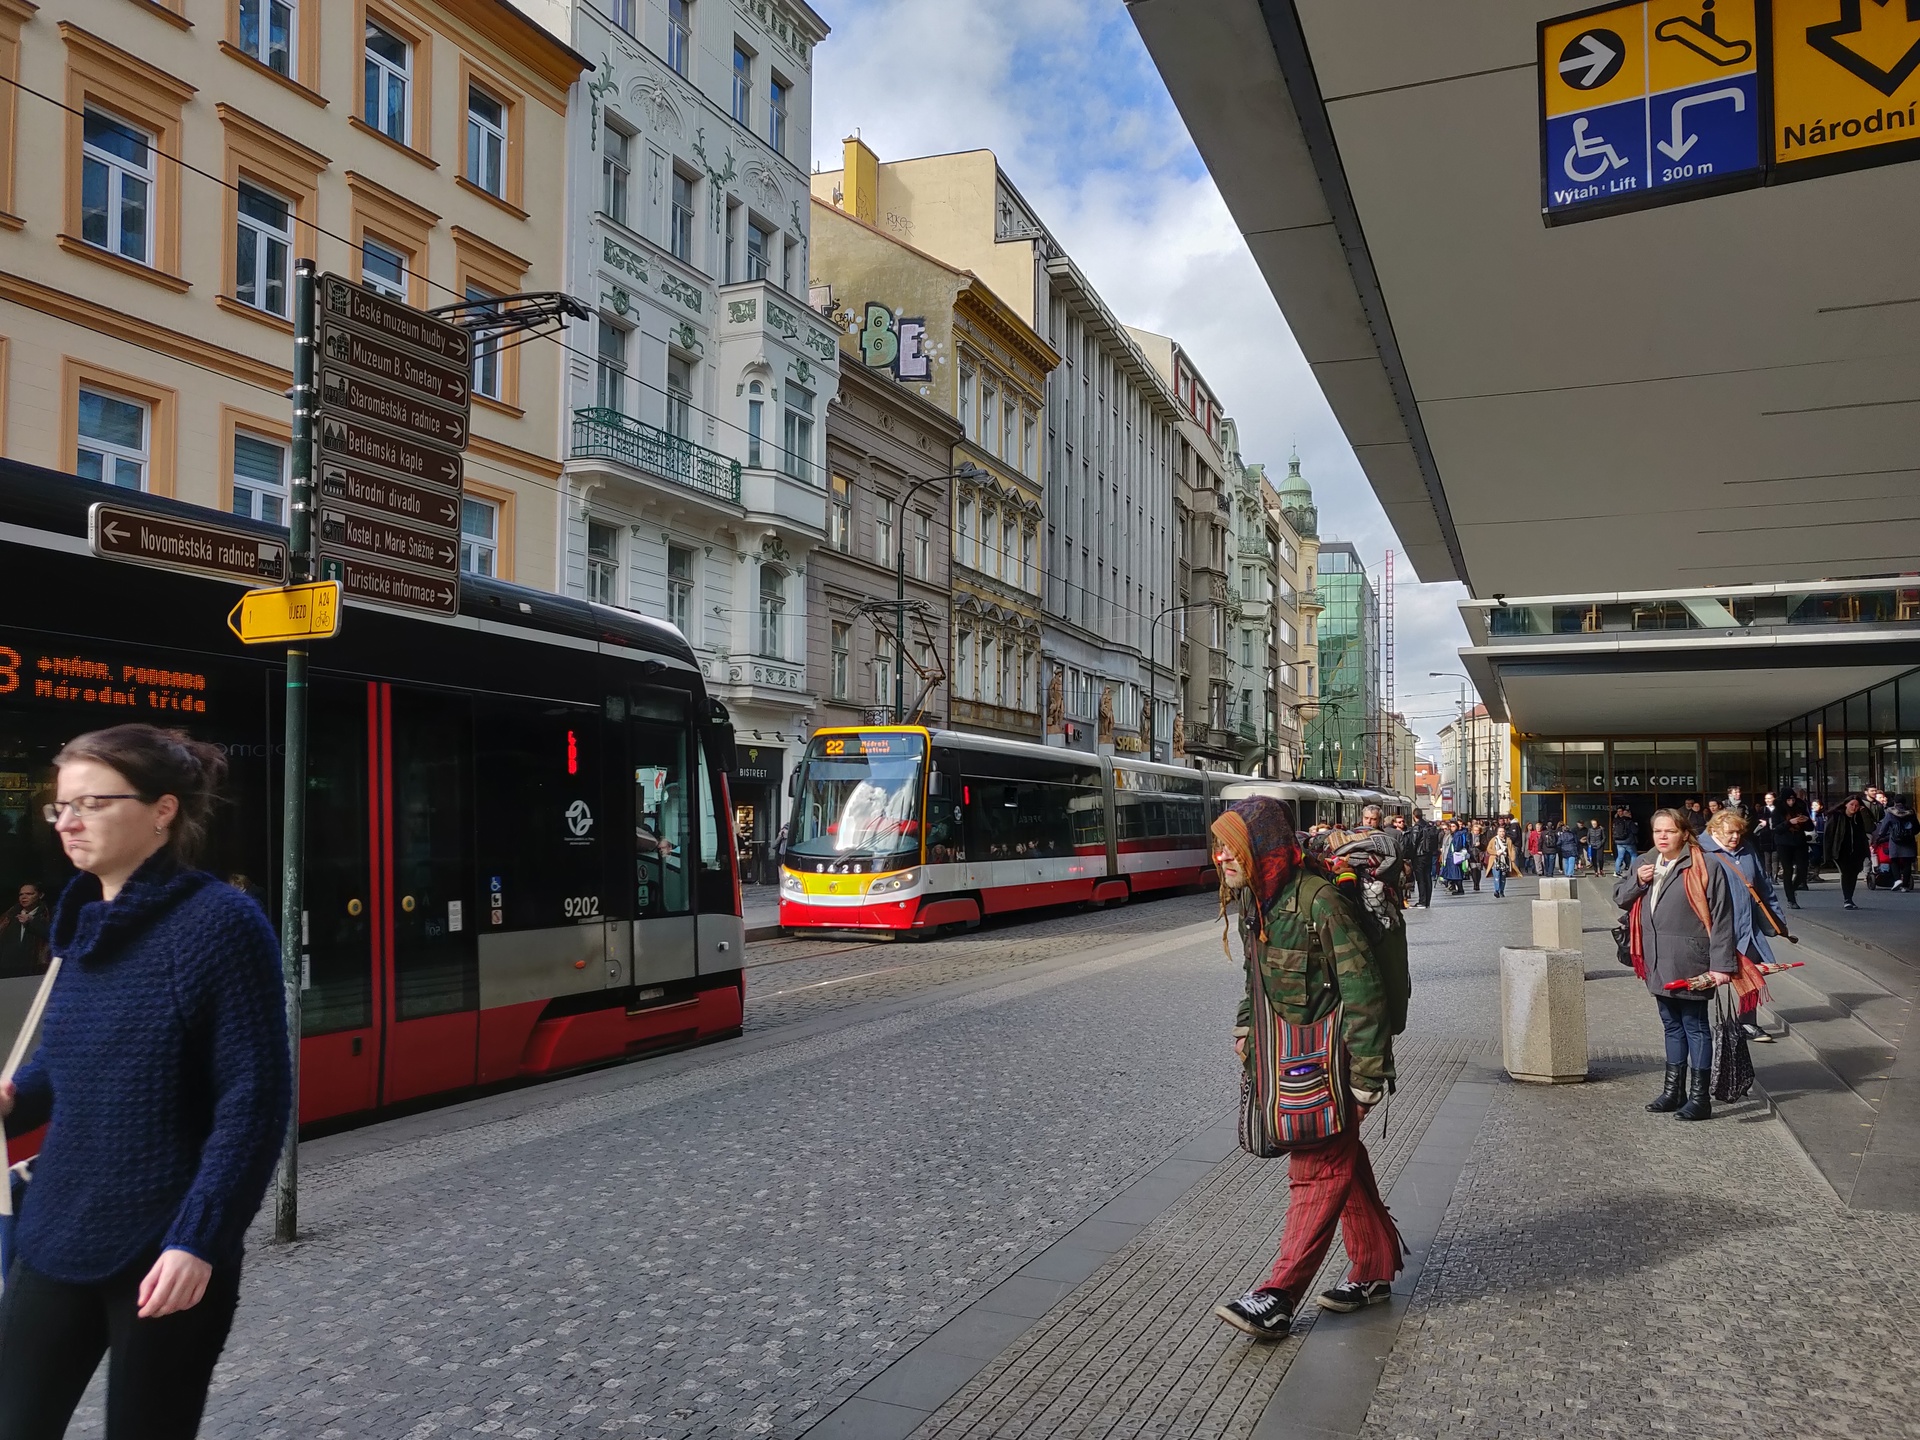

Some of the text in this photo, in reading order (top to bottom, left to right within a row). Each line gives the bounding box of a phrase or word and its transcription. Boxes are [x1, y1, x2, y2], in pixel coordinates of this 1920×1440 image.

[1783, 100, 1918, 150] Národní
[1554, 176, 1637, 205] Výtah Lift
[1662, 162, 1713, 182] 300 m
[354, 292, 446, 354] České muzeum hudby
[353, 341, 443, 395] Muzeum B. Smetany
[350, 385, 440, 433] Staroměstská radnice
[349, 430, 423, 474] Betlémská kaple
[348, 475, 421, 514] Národní divadlo
[140, 525, 256, 568] Novoměstská radnice
[347, 520, 435, 560] Kostel p. Marie Sněžné
[346, 566, 435, 603] Turistické informace
[288, 602, 307, 619] ÚJEZD
[318, 591, 330, 607] A24
[826, 739, 845, 755] 22
[739, 768, 767, 778] BISTREET
[564, 896, 600, 918] 9202
